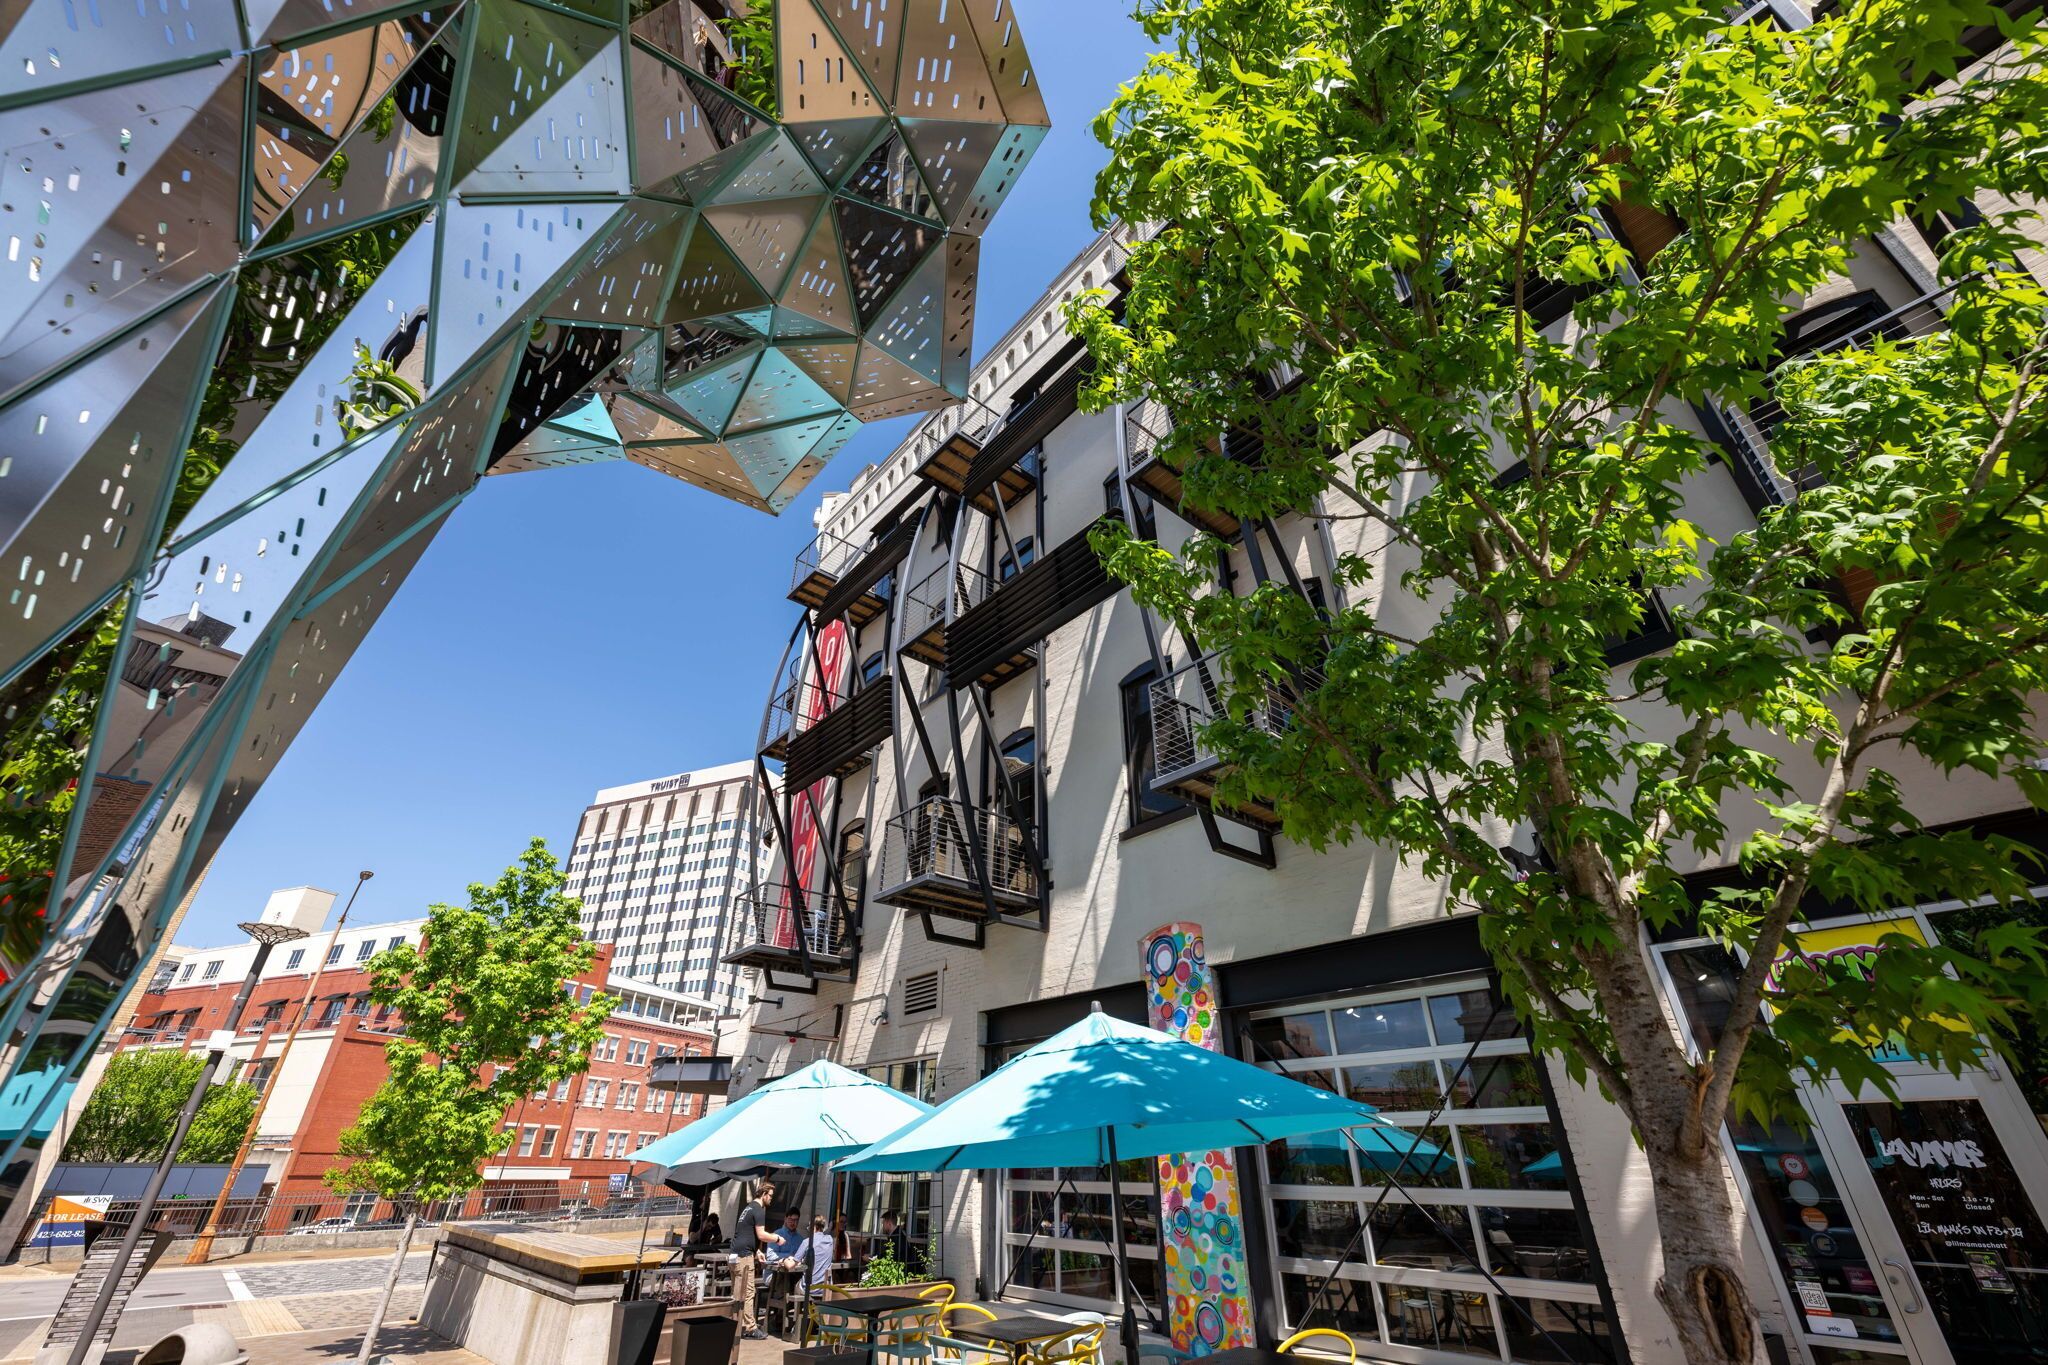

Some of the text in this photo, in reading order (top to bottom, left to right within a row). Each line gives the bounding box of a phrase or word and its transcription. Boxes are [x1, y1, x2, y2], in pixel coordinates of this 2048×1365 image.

[650, 778, 679, 792] TRUIST
[1930, 1178, 1962, 1188] HOURS
[1984, 1196, 1995, 1204] 7p
[47, 1213, 103, 1221] FOR LEASE
[37, 1230, 85, 1238] 423-682-82
[1973, 1226, 1988, 1236] ON
